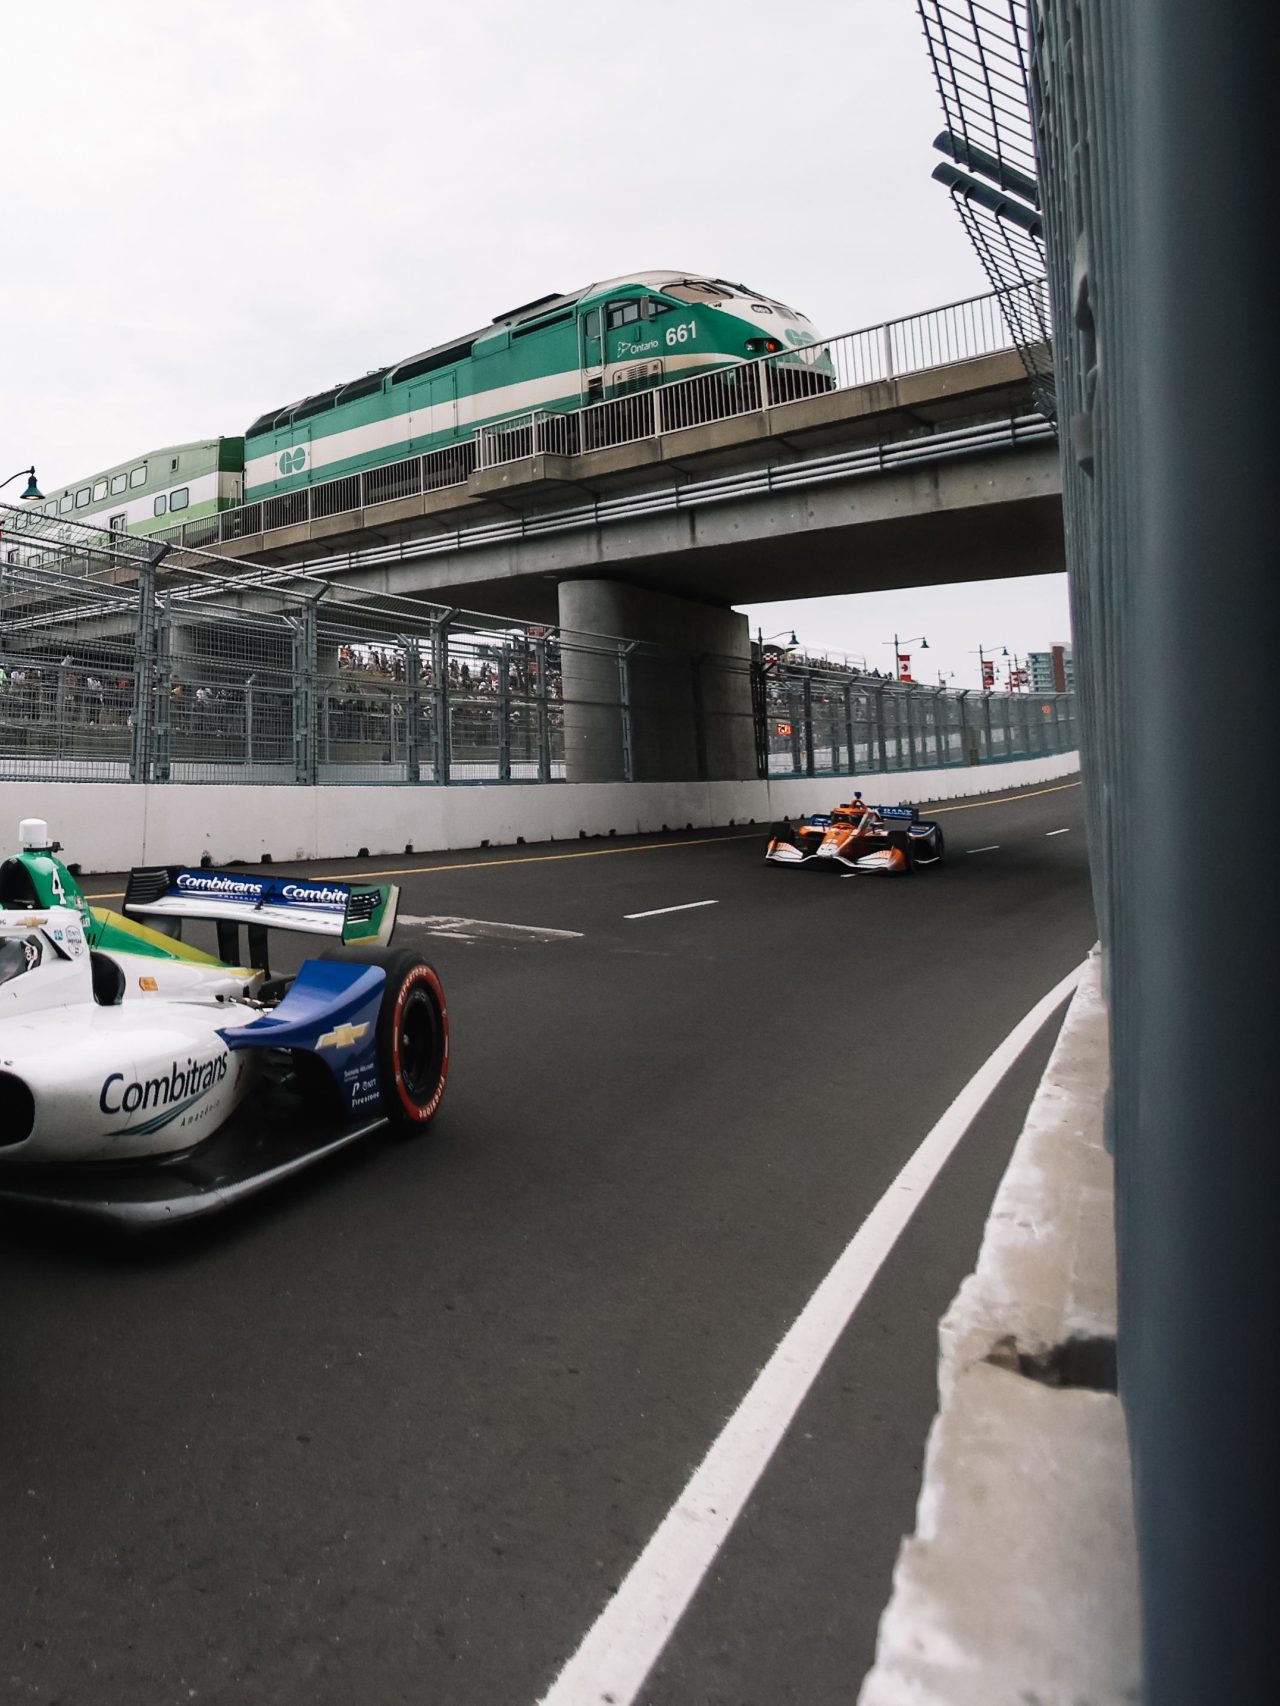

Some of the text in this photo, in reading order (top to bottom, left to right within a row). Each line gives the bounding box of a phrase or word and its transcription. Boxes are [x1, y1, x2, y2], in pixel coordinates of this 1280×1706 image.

[630, 340, 659, 354] Ontario
[665, 320, 697, 346] 661
[278, 446, 306, 475] GO
[52, 866, 68, 905] 4
[176, 873, 263, 894] Combitrans
[397, 967, 428, 1005] Firestone
[99, 1050, 228, 1115] Combitrans
[418, 1074, 446, 1119] Firestone
